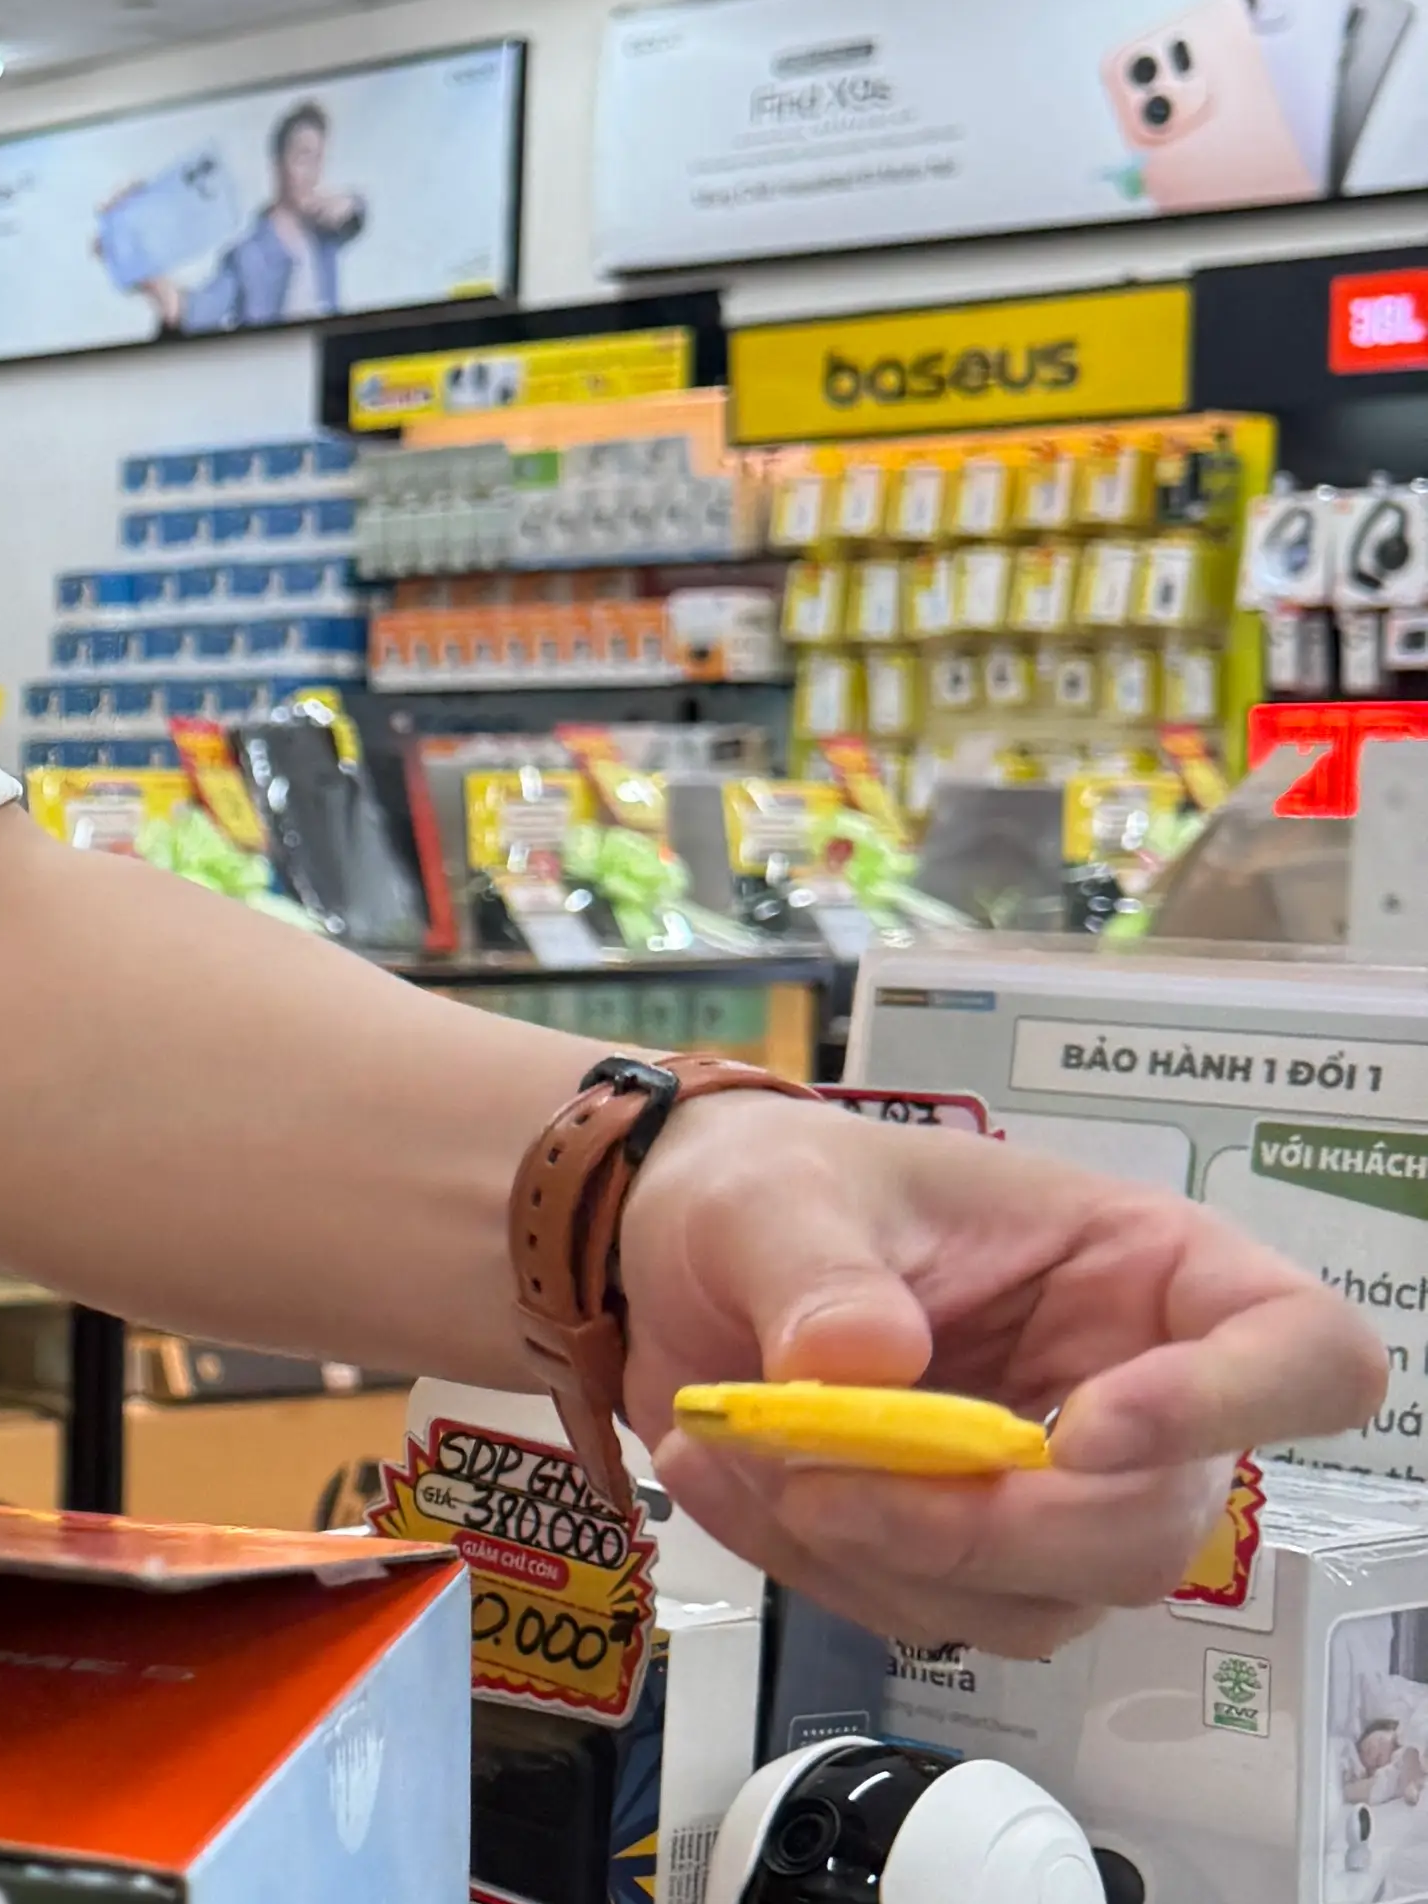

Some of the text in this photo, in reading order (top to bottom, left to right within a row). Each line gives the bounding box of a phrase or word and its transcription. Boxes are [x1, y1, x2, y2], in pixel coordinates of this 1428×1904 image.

[822, 337, 1080, 408] baseus
[1061, 1036, 1138, 1074] BẢO
[1148, 1044, 1251, 1084] HÀNH
[1263, 1057, 1277, 1086] 1
[1287, 1051, 1357, 1092] ĐỔI
[1259, 1134, 1314, 1171] VỚI
[461, 1537, 498, 1565] GIẢM
[528, 1554, 560, 1581] CÒN
